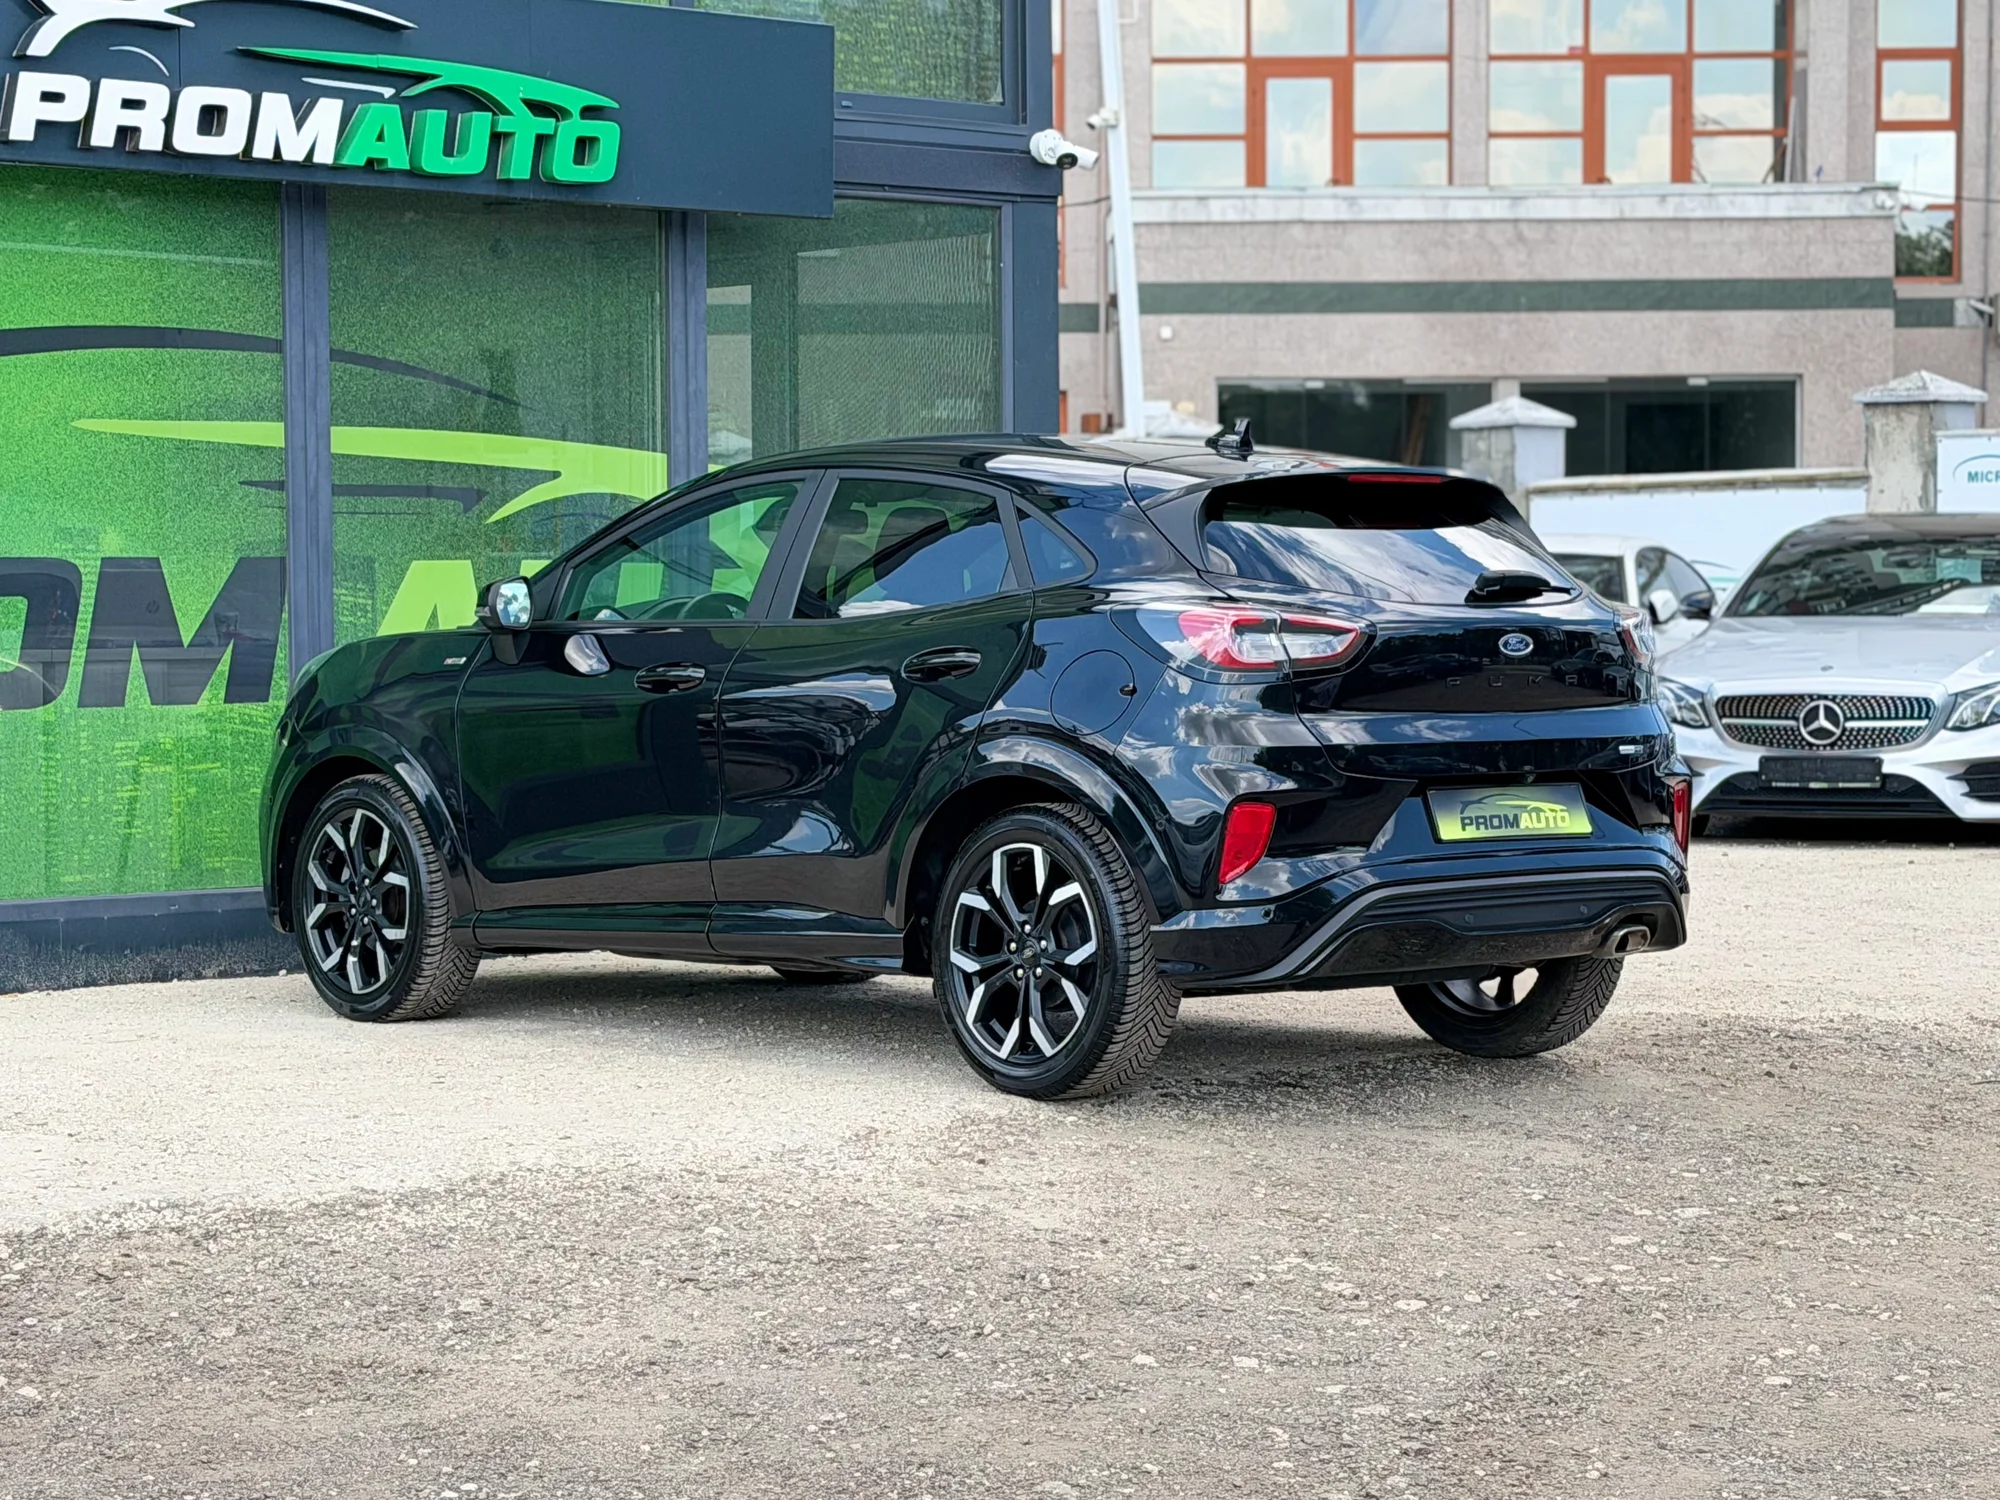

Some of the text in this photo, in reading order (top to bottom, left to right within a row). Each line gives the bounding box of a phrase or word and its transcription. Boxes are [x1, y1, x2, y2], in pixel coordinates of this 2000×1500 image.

[5, 70, 621, 185] PROMAUTO
[1506, 637, 1527, 651] Ford
[1446, 674, 1578, 688] PUMA
[1460, 811, 1571, 832] PROMAUTO
